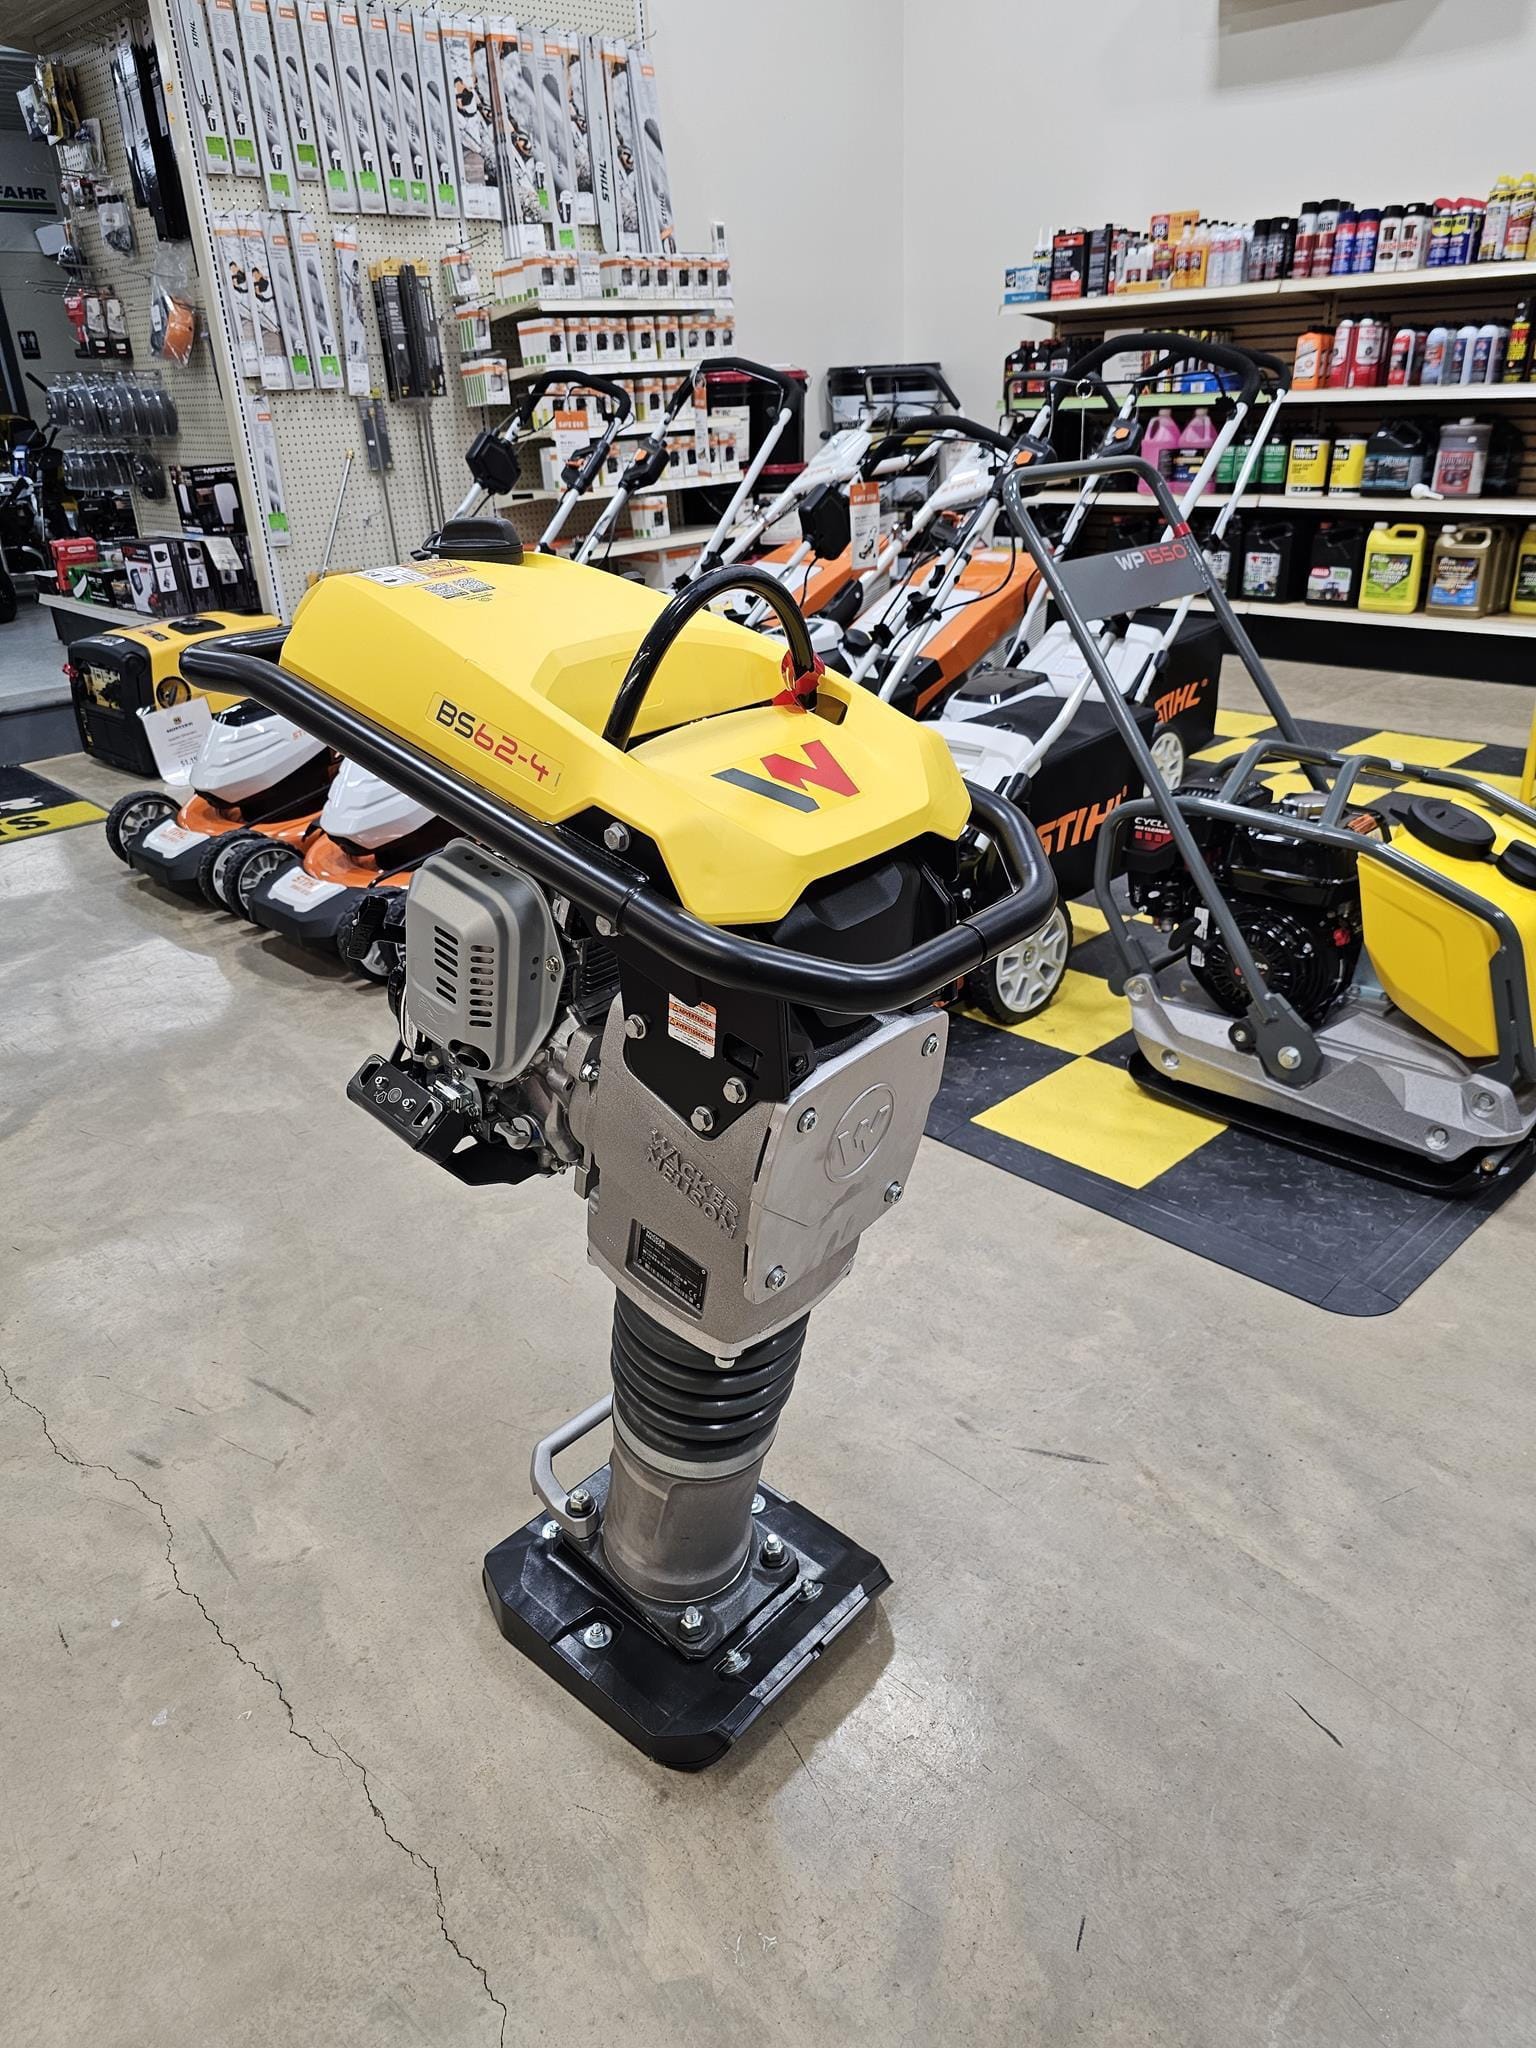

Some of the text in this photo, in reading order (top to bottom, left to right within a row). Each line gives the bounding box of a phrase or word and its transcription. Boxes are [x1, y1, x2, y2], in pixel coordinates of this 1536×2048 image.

[190, 19, 200, 48] STIHL
[265, 105, 273, 130] STIHL
[0, 185, 47, 200] AHR
[599, 160, 610, 203] STIHL
[658, 192, 667, 225] STIHL
[1114, 544, 1187, 571] WP1550
[1154, 682, 1201, 724] STIHL
[436, 700, 549, 782] BS62-4
[676, 1022, 714, 1043] AVERTISSEMENT
[679, 1007, 713, 1027] ADVERTENCIA
[651, 1128, 740, 1222] WACKER
[646, 1144, 737, 1239] NEUSON
